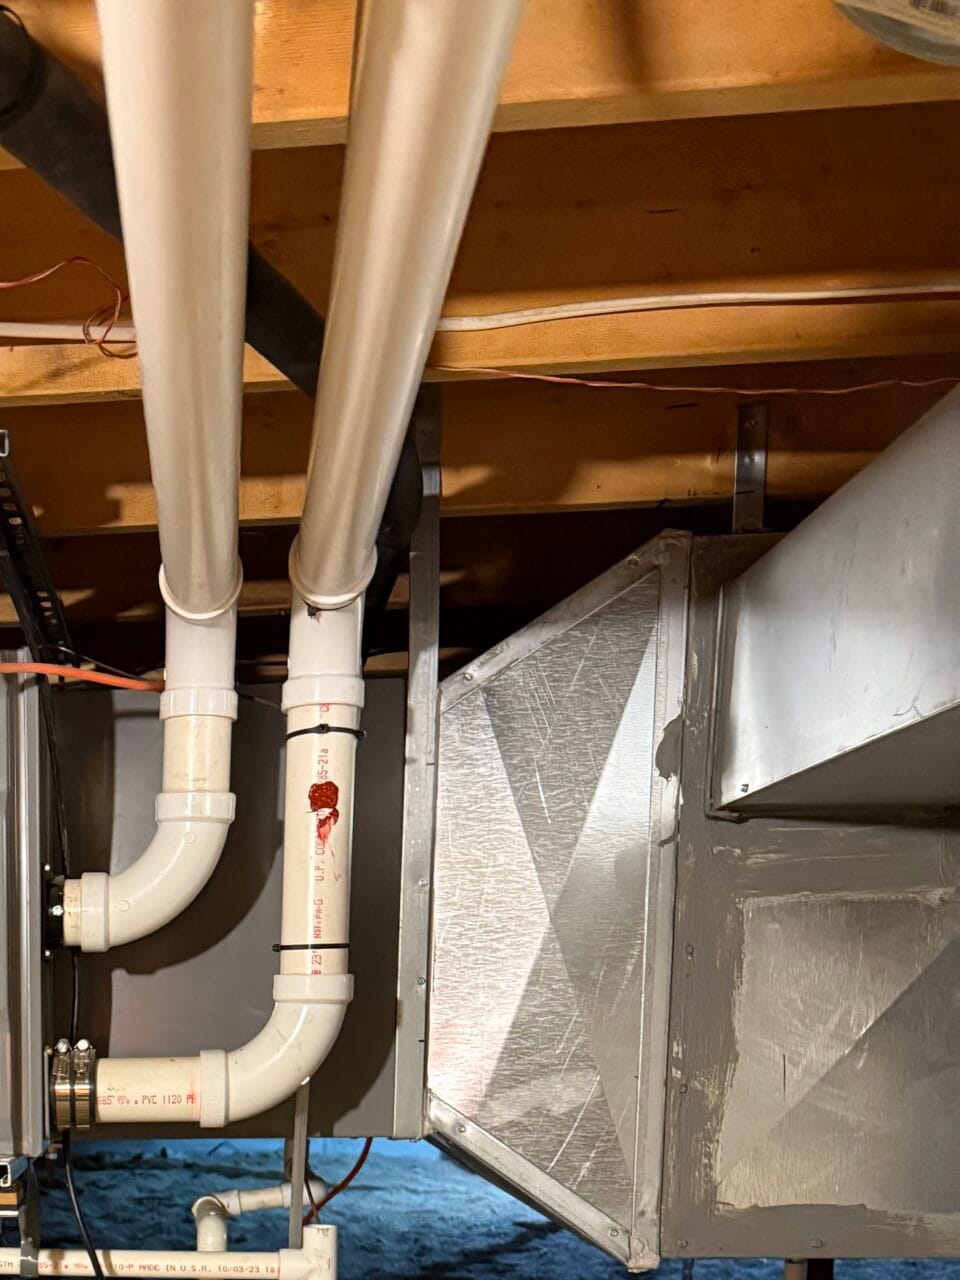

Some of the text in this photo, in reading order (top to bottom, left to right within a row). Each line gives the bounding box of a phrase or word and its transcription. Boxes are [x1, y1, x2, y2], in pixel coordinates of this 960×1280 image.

[142, 1095, 157, 1105] PVC
[163, 1095, 182, 1105] 1120
[139, 1264, 161, 1272] MADE
[166, 1264, 176, 1272] IN
[180, 1265, 211, 1273] U.S.A.
[218, 1265, 260, 1274] 10/03/23
